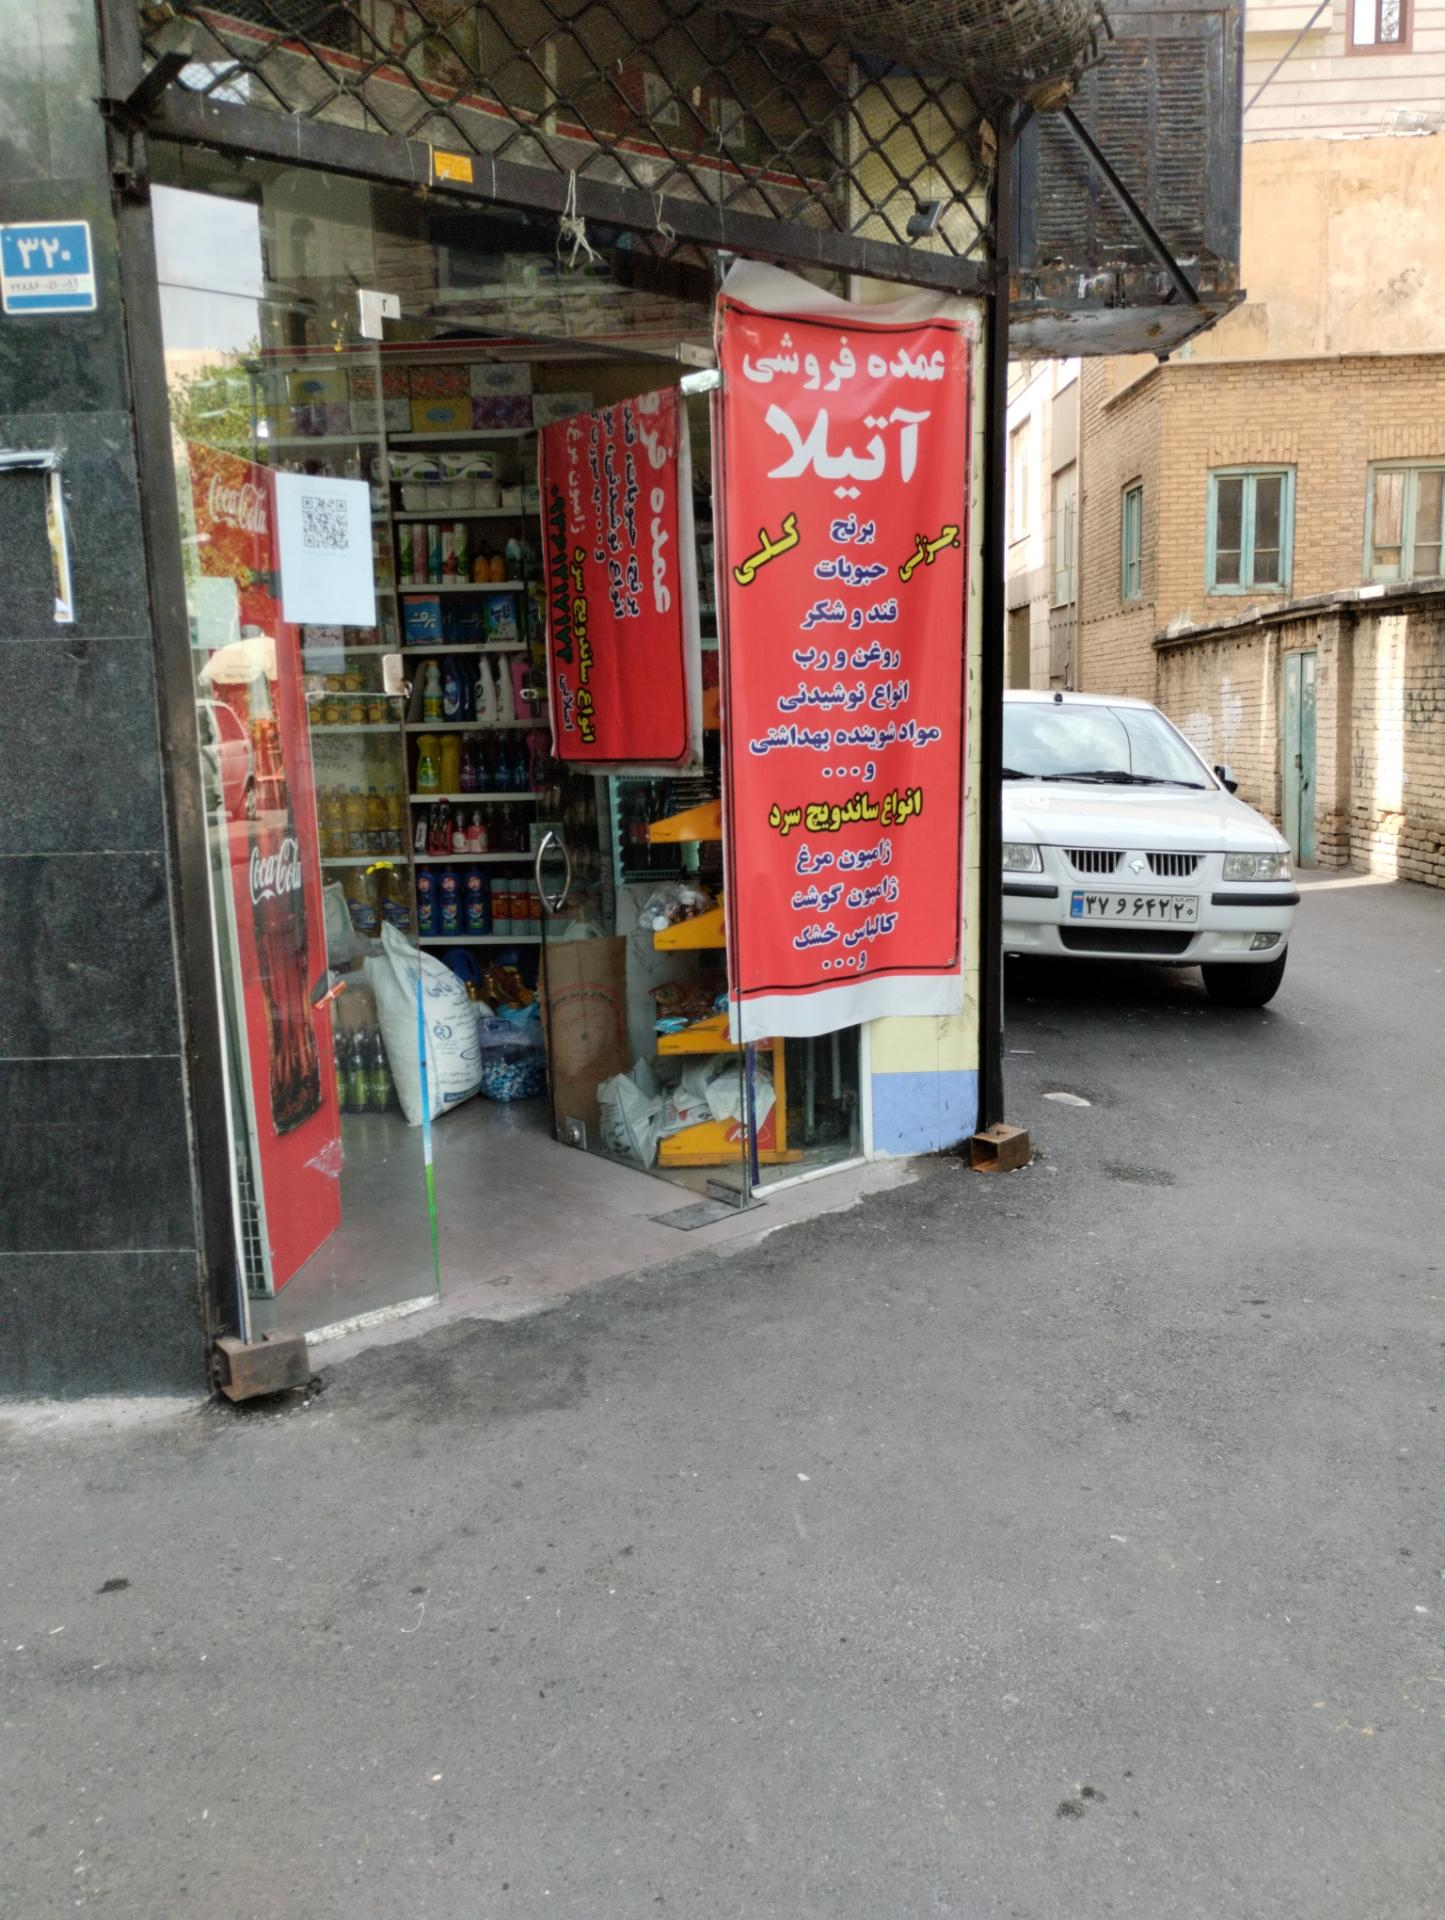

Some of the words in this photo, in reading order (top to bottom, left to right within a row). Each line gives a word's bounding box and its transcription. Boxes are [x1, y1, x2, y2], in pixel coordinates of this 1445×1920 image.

[16, 237, 72, 269] ۳۲۰
[742, 332, 857, 391] فروشی
[867, 347, 945, 381] عمده
[764, 403, 931, 499] آتیلا
[831, 513, 876, 544] برنج
[651, 488, 671, 612] عمده
[733, 512, 800, 586] کلی
[815, 555, 887, 587] حبوبات
[800, 598, 846, 629] شکر
[850, 607, 863, 629] و
[867, 598, 898, 622] قند
[573, 598, 594, 686] ساندویچ
[851, 640, 900, 669] روغن
[794, 647, 828, 669] رب
[832, 648, 847, 670] و
[778, 682, 866, 711] نوشیدنی
[870, 681, 909, 709] انواع
[575, 687, 597, 744] انواع
[750, 724, 829, 754] بهداشتی
[835, 721, 896, 750] شوینده
[897, 720, 941, 746] مواد
[767, 802, 803, 836] سرد
[805, 792, 880, 833] ساندویچ
[880, 788, 922, 827] انواع
[795, 844, 833, 874] مرغ
[837, 839, 893, 870] ژامبون
[791, 882, 843, 912] گوشت
[847, 875, 899, 908] ژامبون
[1086, 896, 1109, 915] ۳۷
[1115, 898, 1127, 914] و
[1174, 903, 1194, 919] ۲۰
[793, 922, 840, 949] خشک
[843, 912, 897, 947] کالباس
